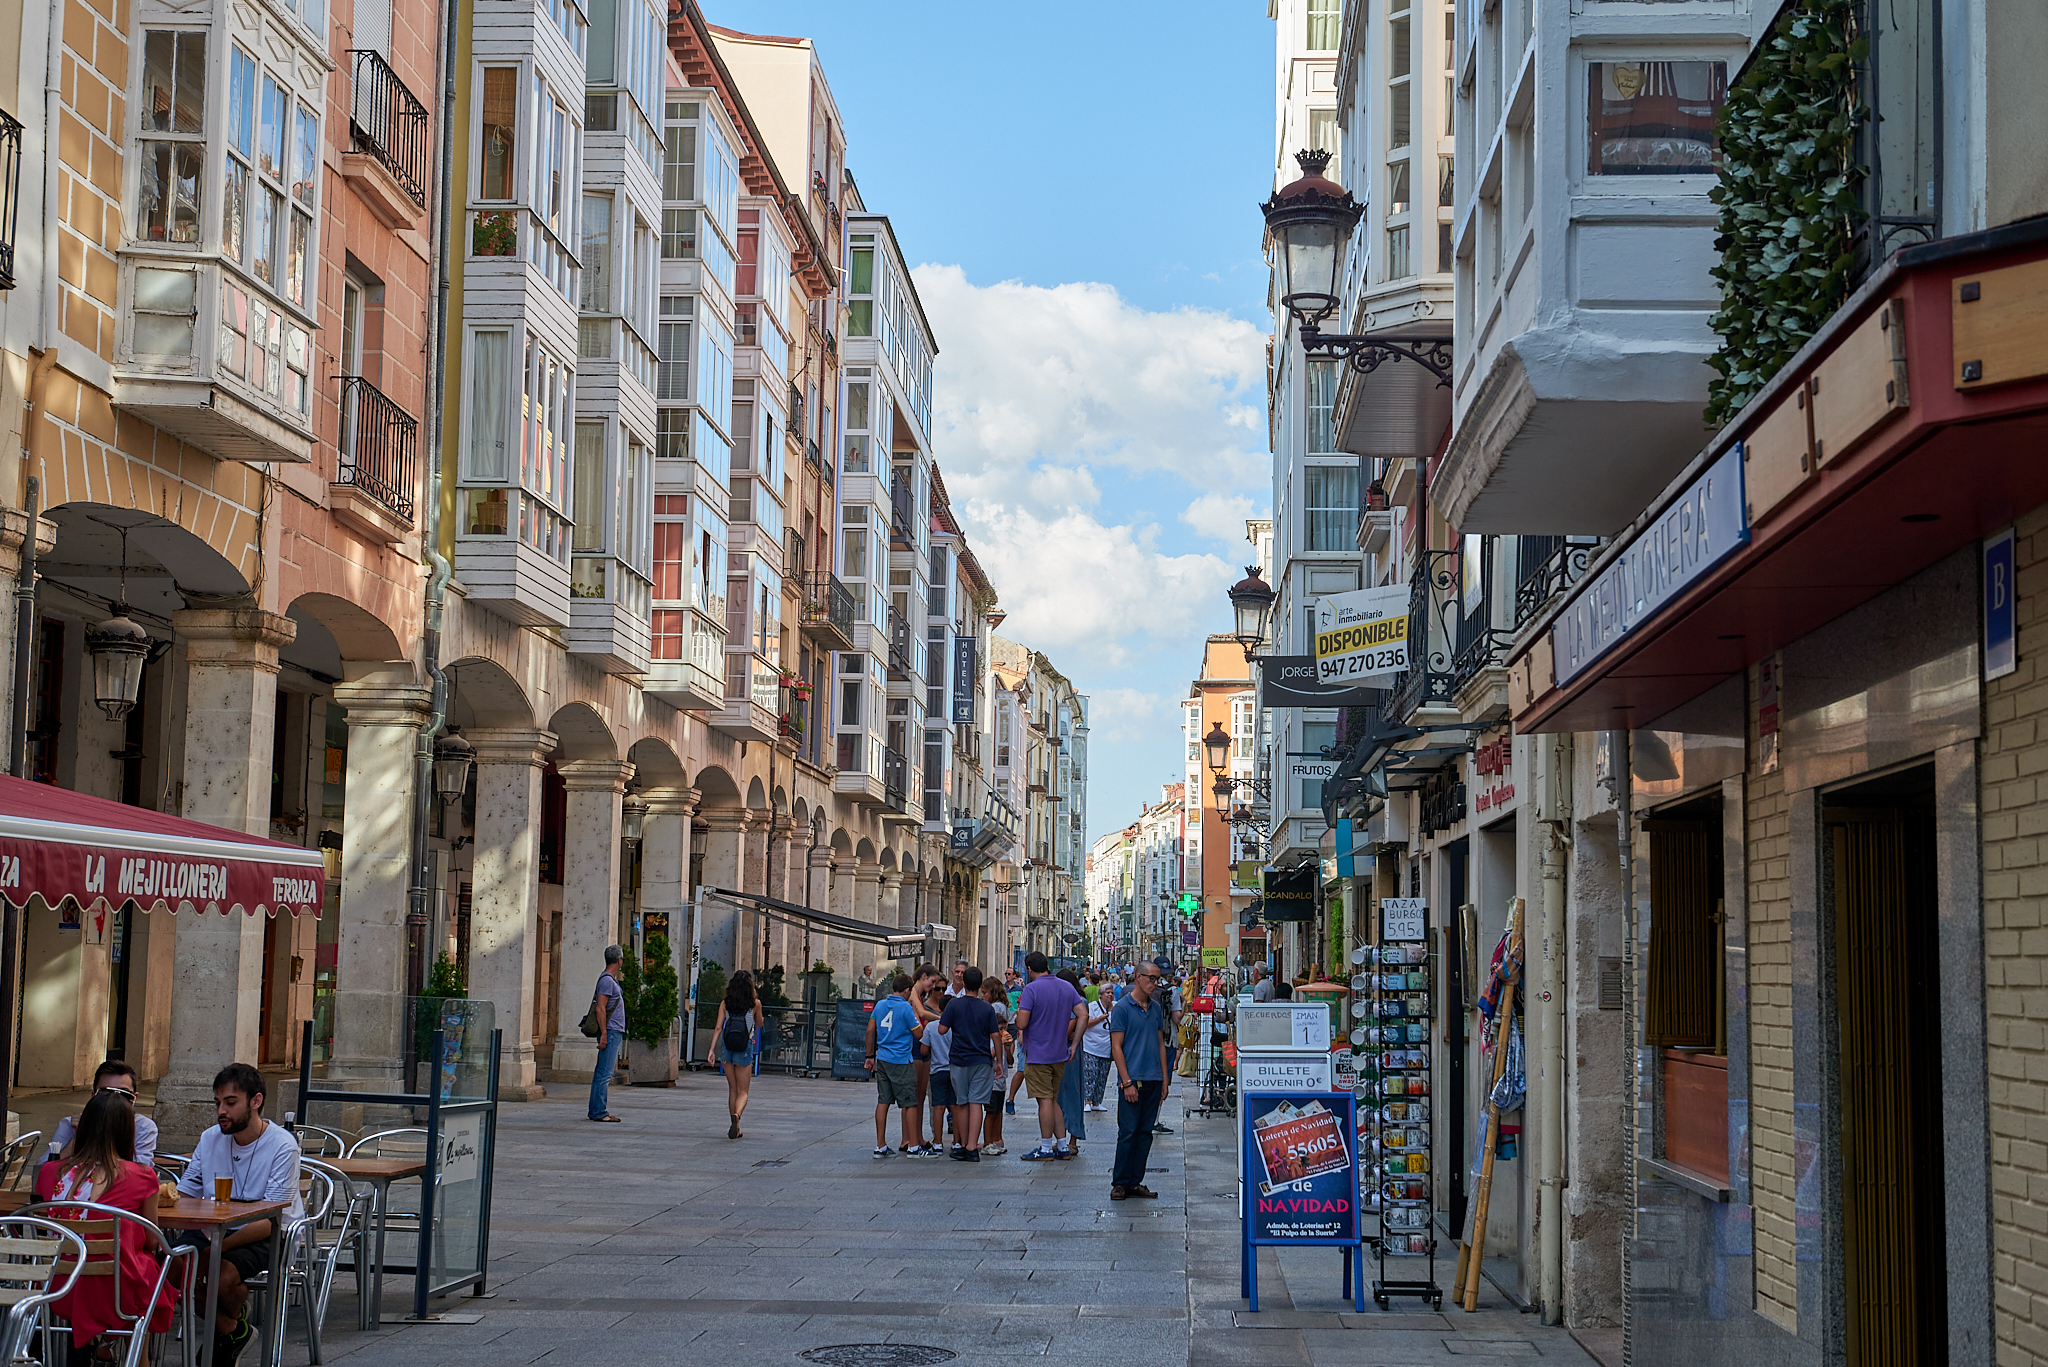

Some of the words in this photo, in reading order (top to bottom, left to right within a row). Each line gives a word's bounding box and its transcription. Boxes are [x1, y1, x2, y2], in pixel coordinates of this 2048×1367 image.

[1568, 606, 1585, 668] LA
[1589, 487, 1709, 650] MEJILLONERA
[1993, 562, 2006, 611] B
[1338, 607, 1354, 616] arte
[1338, 609, 1383, 624] inmobiliario
[1319, 618, 1405, 655] DISPONIBLE
[1321, 658, 1346, 678] 947
[1349, 653, 1374, 673] 270
[1377, 648, 1405, 668] 236
[1280, 666, 1315, 680] JORGE
[1292, 765, 1332, 776] FRUTOS
[85, 854, 106, 893] LA
[118, 857, 228, 901] MEJILLONERA
[272, 876, 317, 904] TERRAZA
[1265, 891, 1313, 900] SCANDALO
[1384, 899, 1418, 909] TAZA
[1390, 909, 1425, 920] BURGOS
[880, 1010, 894, 1031] 4
[1244, 1011, 1291, 1019] RECUERDOS
[1258, 1066, 1310, 1075] BILLETE
[1246, 1079, 1303, 1087] SOUVENIR
[1290, 1126, 1300, 1134] de
[1301, 1115, 1334, 1131] Navidad
[1287, 1133, 1338, 1160] 55605
[1292, 1180, 1313, 1192] de
[1259, 1198, 1349, 1213] NAVIDAD
